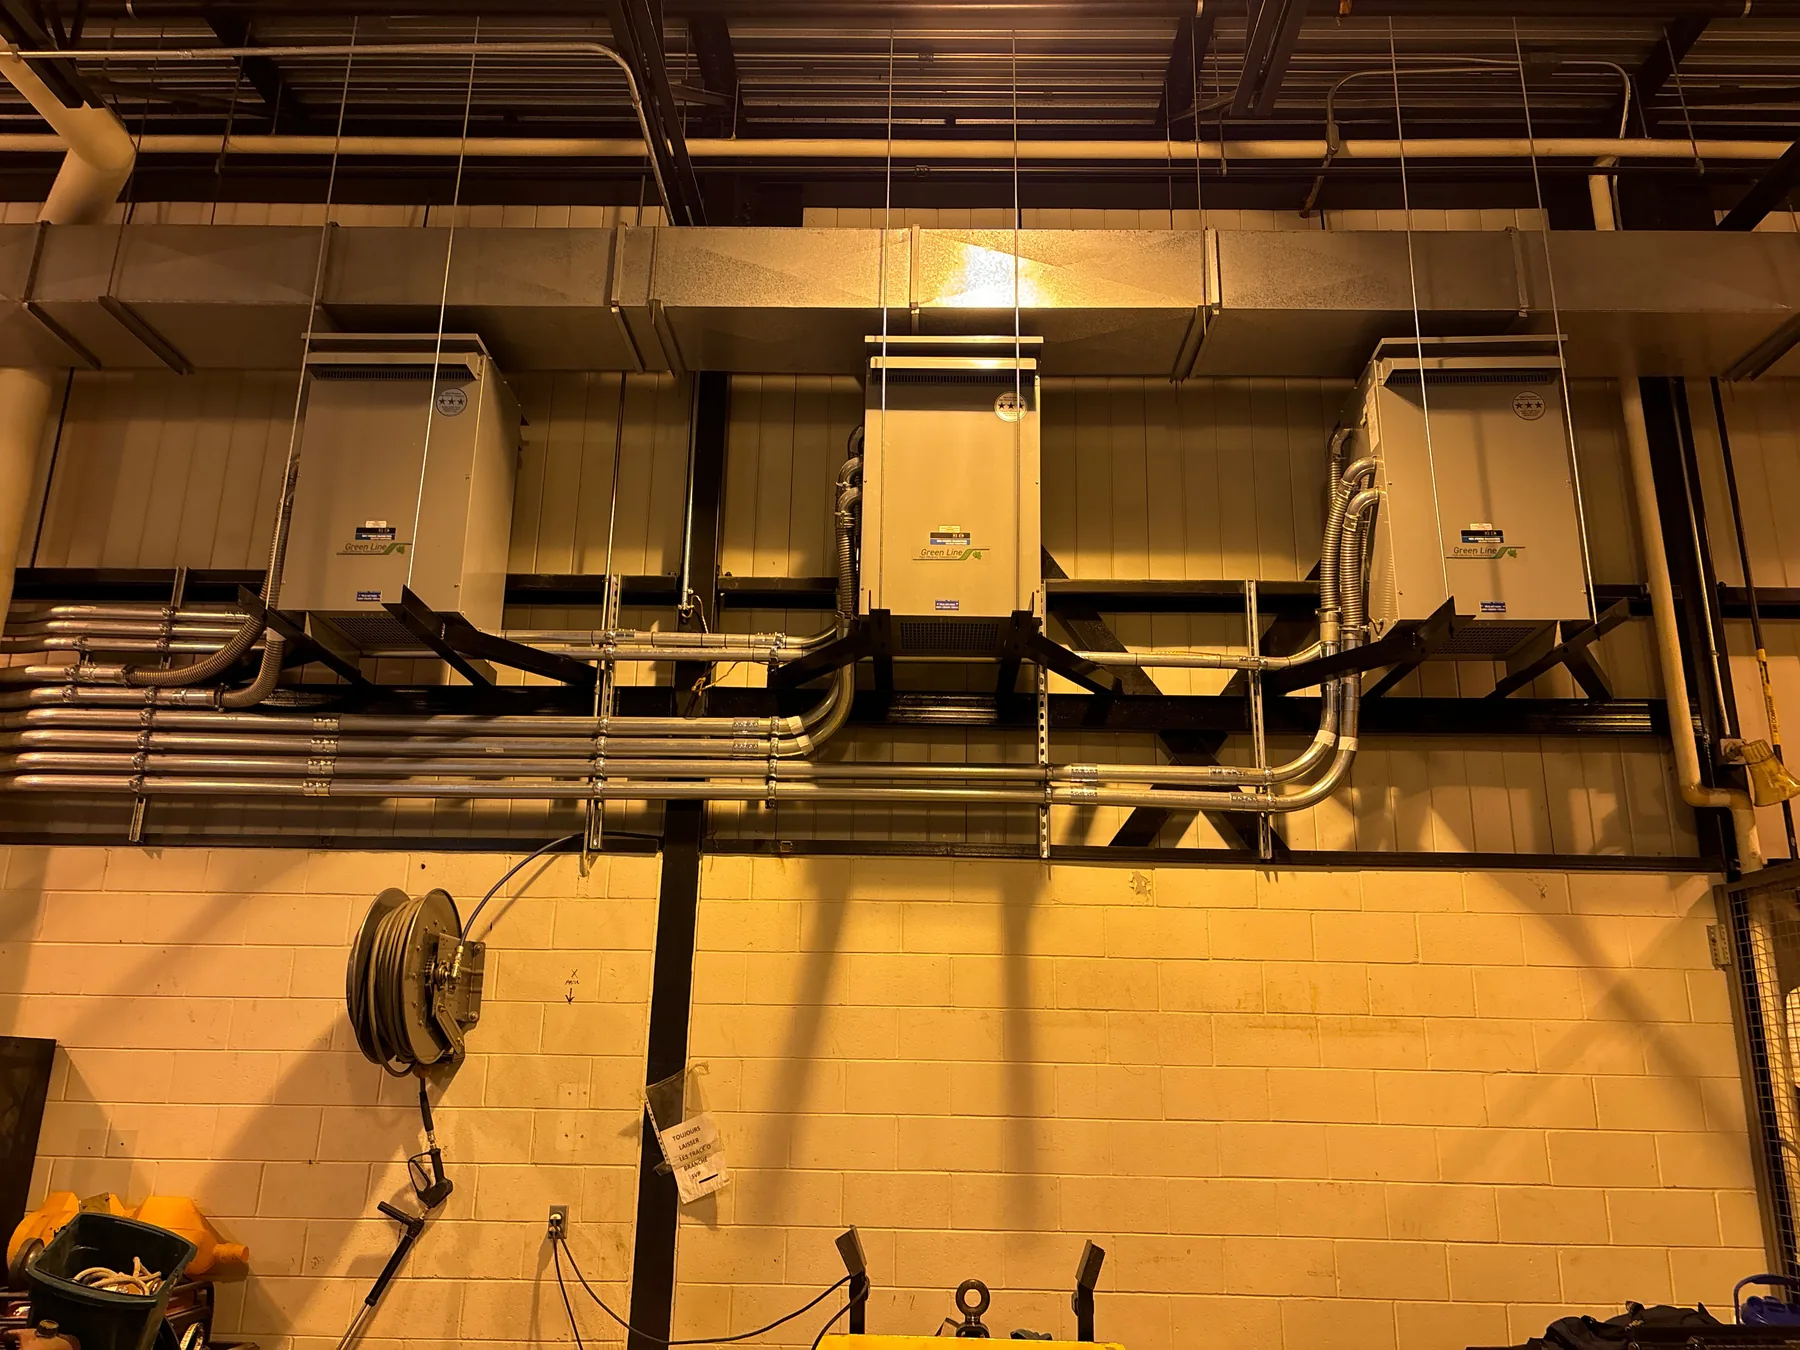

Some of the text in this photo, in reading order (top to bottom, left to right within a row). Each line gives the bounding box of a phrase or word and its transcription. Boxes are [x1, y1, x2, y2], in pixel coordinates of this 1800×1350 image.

[344, 543, 369, 551] Green
[370, 543, 387, 551] Line
[1453, 546, 1498, 554] Green Line
[920, 548, 963, 556] Green Line
[672, 1125, 701, 1142] TOUJOURS
[678, 1137, 700, 1151] LAISSER
[678, 1153, 689, 1162] LES
[691, 1170, 702, 1180] SVP
